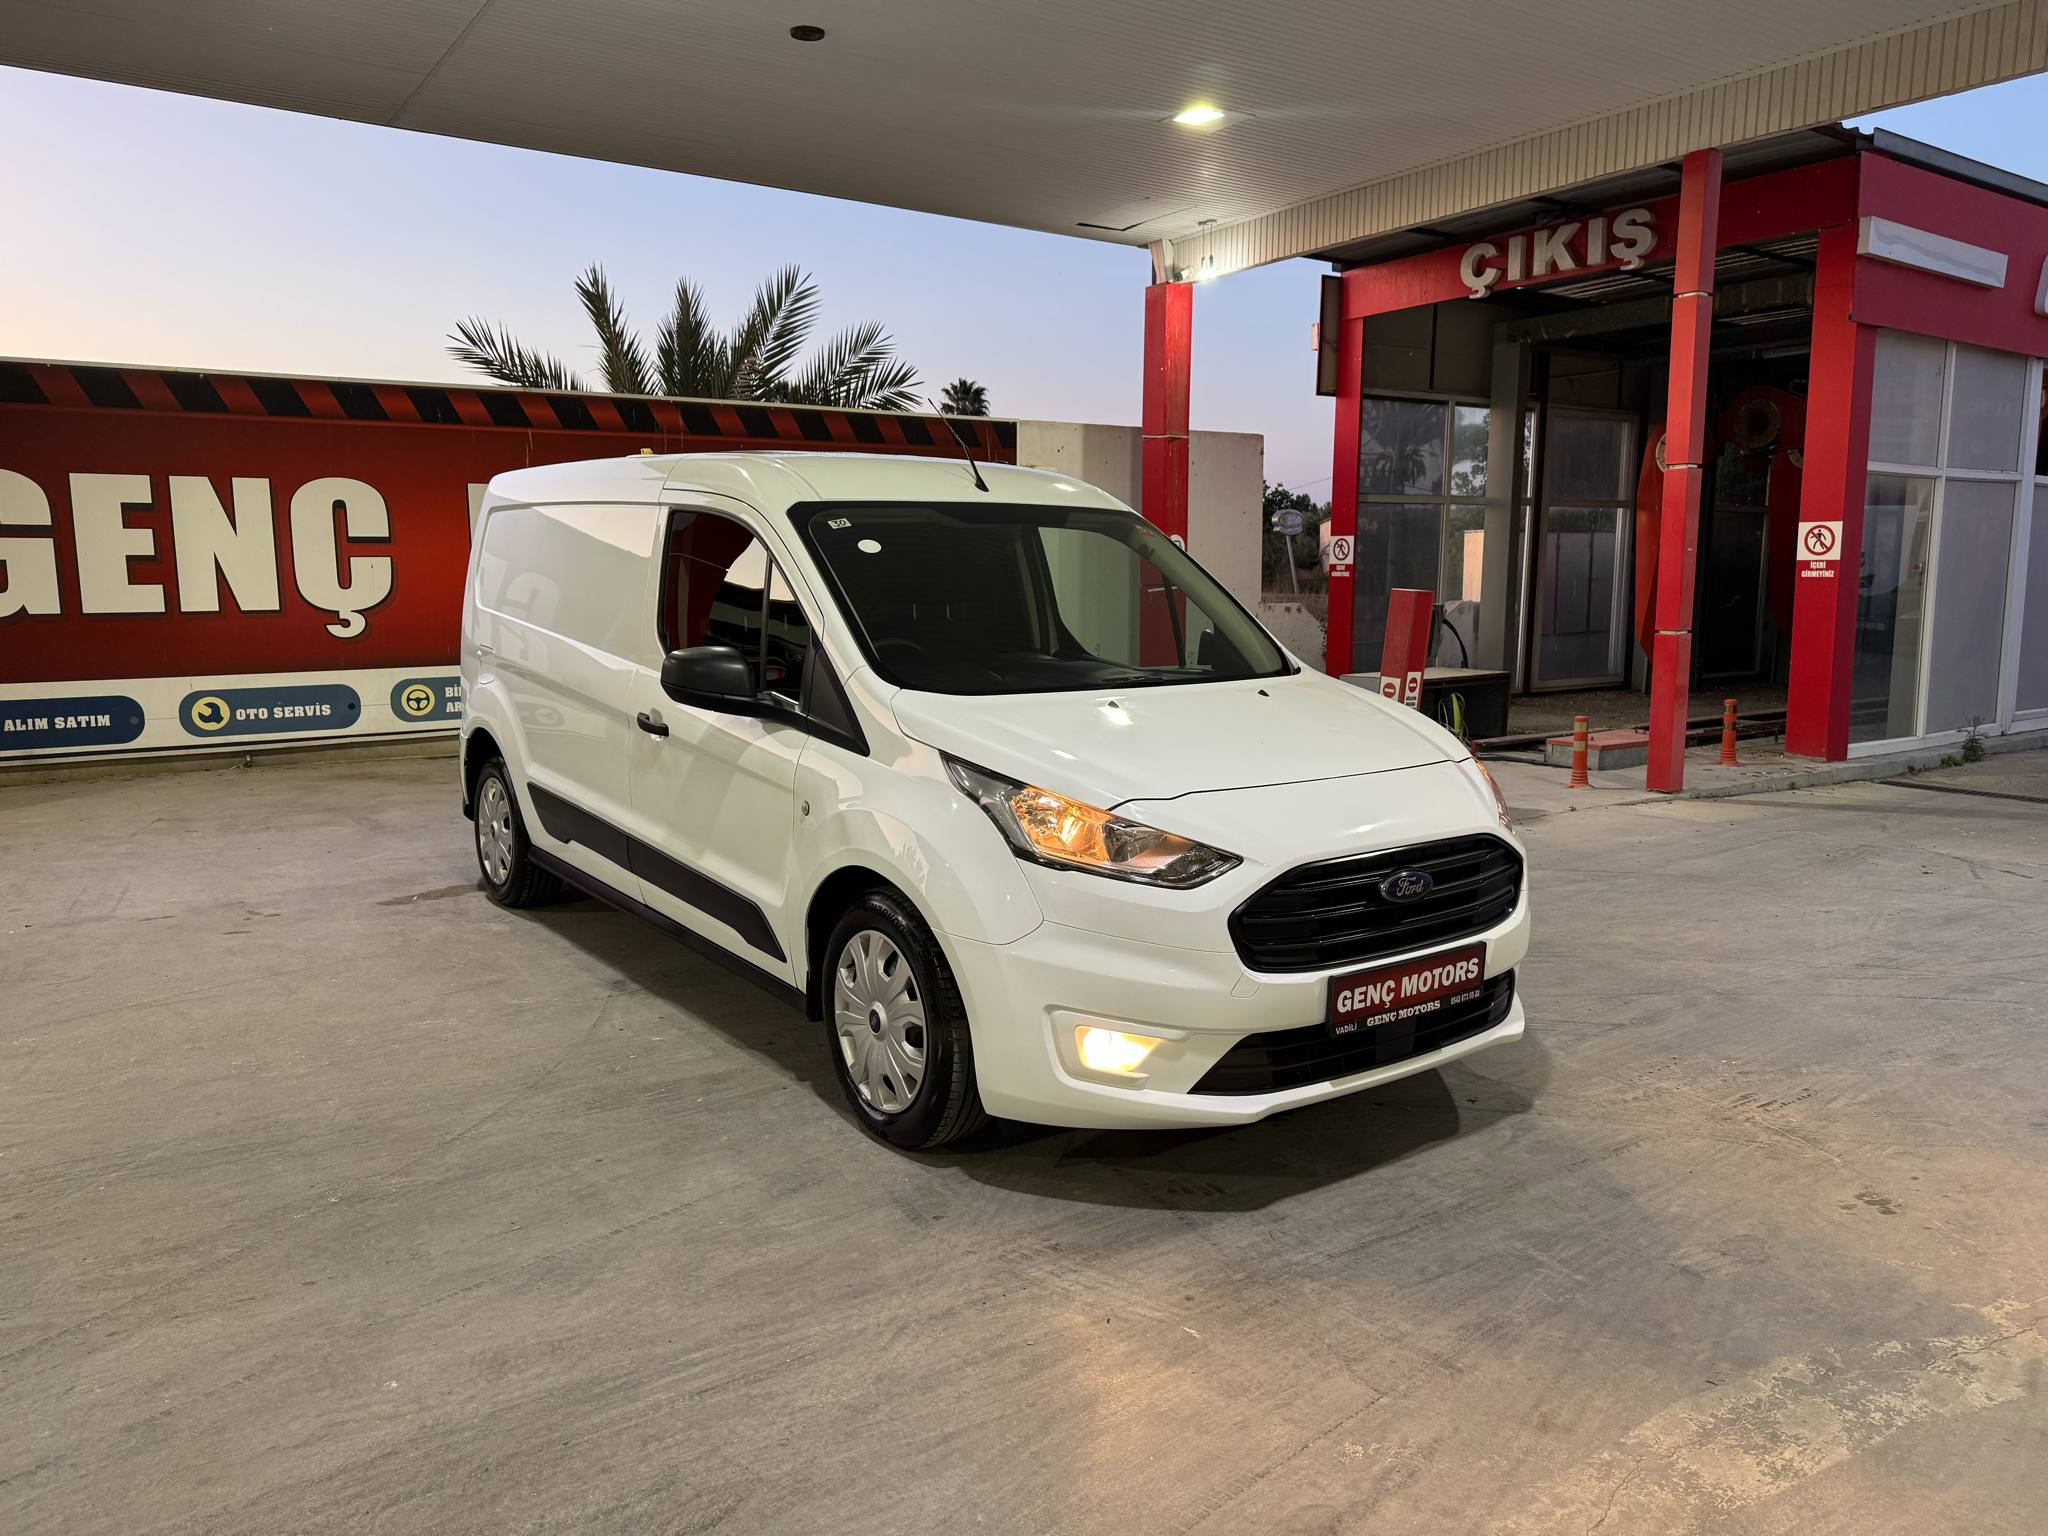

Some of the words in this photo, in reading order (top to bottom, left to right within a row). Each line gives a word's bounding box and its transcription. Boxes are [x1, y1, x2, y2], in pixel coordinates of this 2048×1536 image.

[1460, 208, 1657, 299] ÇIKIŞ
[0, 468, 392, 638] GENÇ
[235, 708, 268, 721] OTO
[273, 702, 331, 718] SERVİS
[4, 717, 49, 732] ALIM
[54, 715, 111, 729] SATIM
[1396, 876, 1425, 896] Ford
[1337, 980, 1396, 1013] GENÇ
[1400, 957, 1480, 998] MOTORS
[1398, 1000, 1441, 1019] MOTORS
